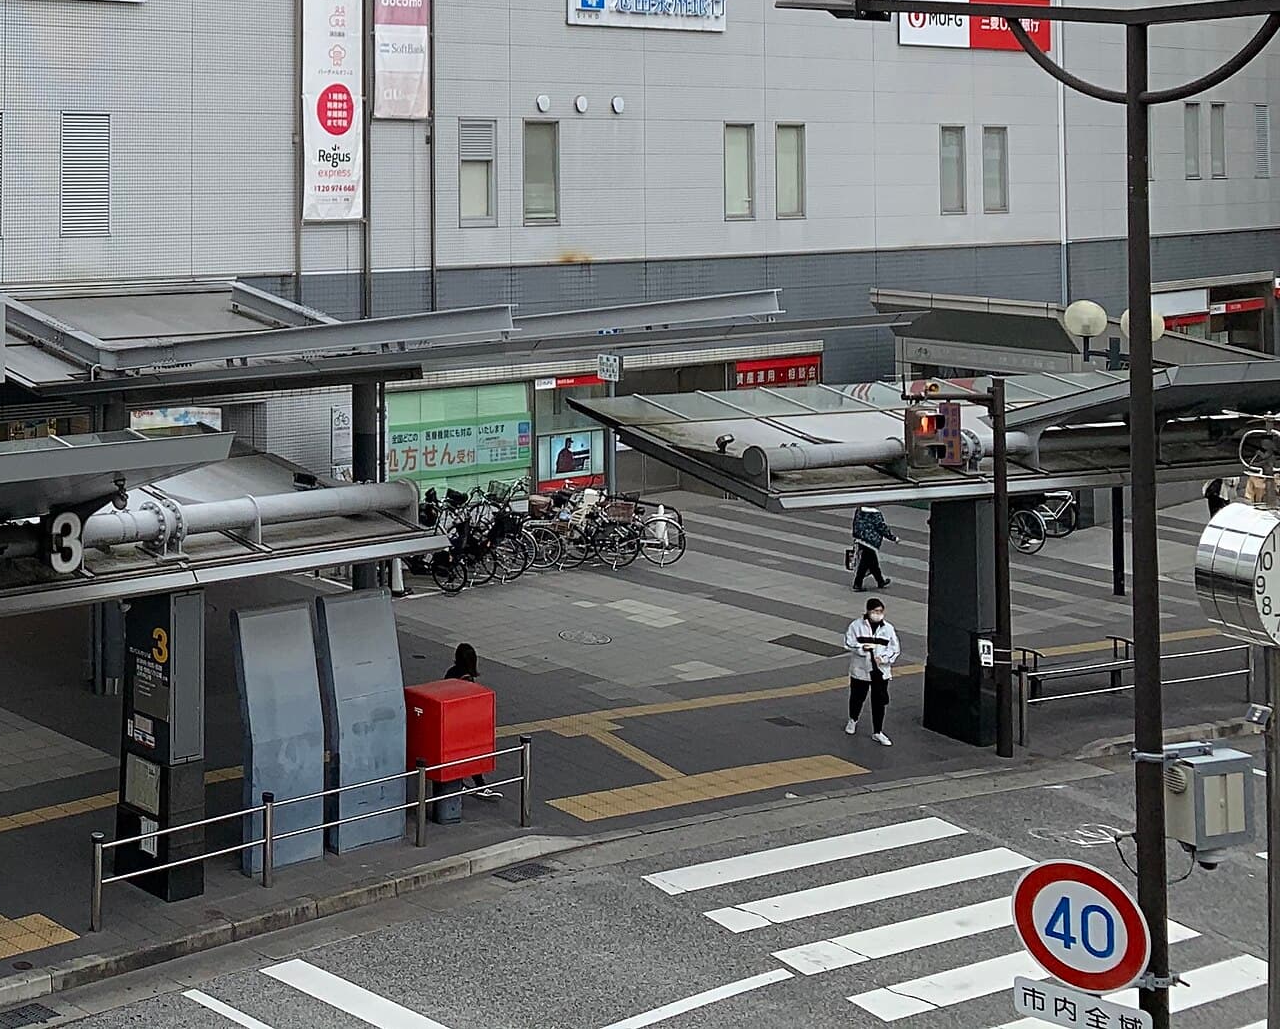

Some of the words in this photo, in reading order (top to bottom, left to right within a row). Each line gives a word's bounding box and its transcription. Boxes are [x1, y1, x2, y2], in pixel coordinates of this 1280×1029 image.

[928, 12, 963, 28] MUFG
[391, 42, 425, 55] SoftBank
[318, 145, 351, 169] Regus
[318, 170, 352, 180] express
[50, 511, 84, 573] 3
[1256, 575, 1266, 595] 9
[1262, 596, 1272, 616] 8
[152, 627, 169, 664] 3
[1044, 896, 1115, 959] 40
[1022, 985, 1144, 1029] 市内全域
